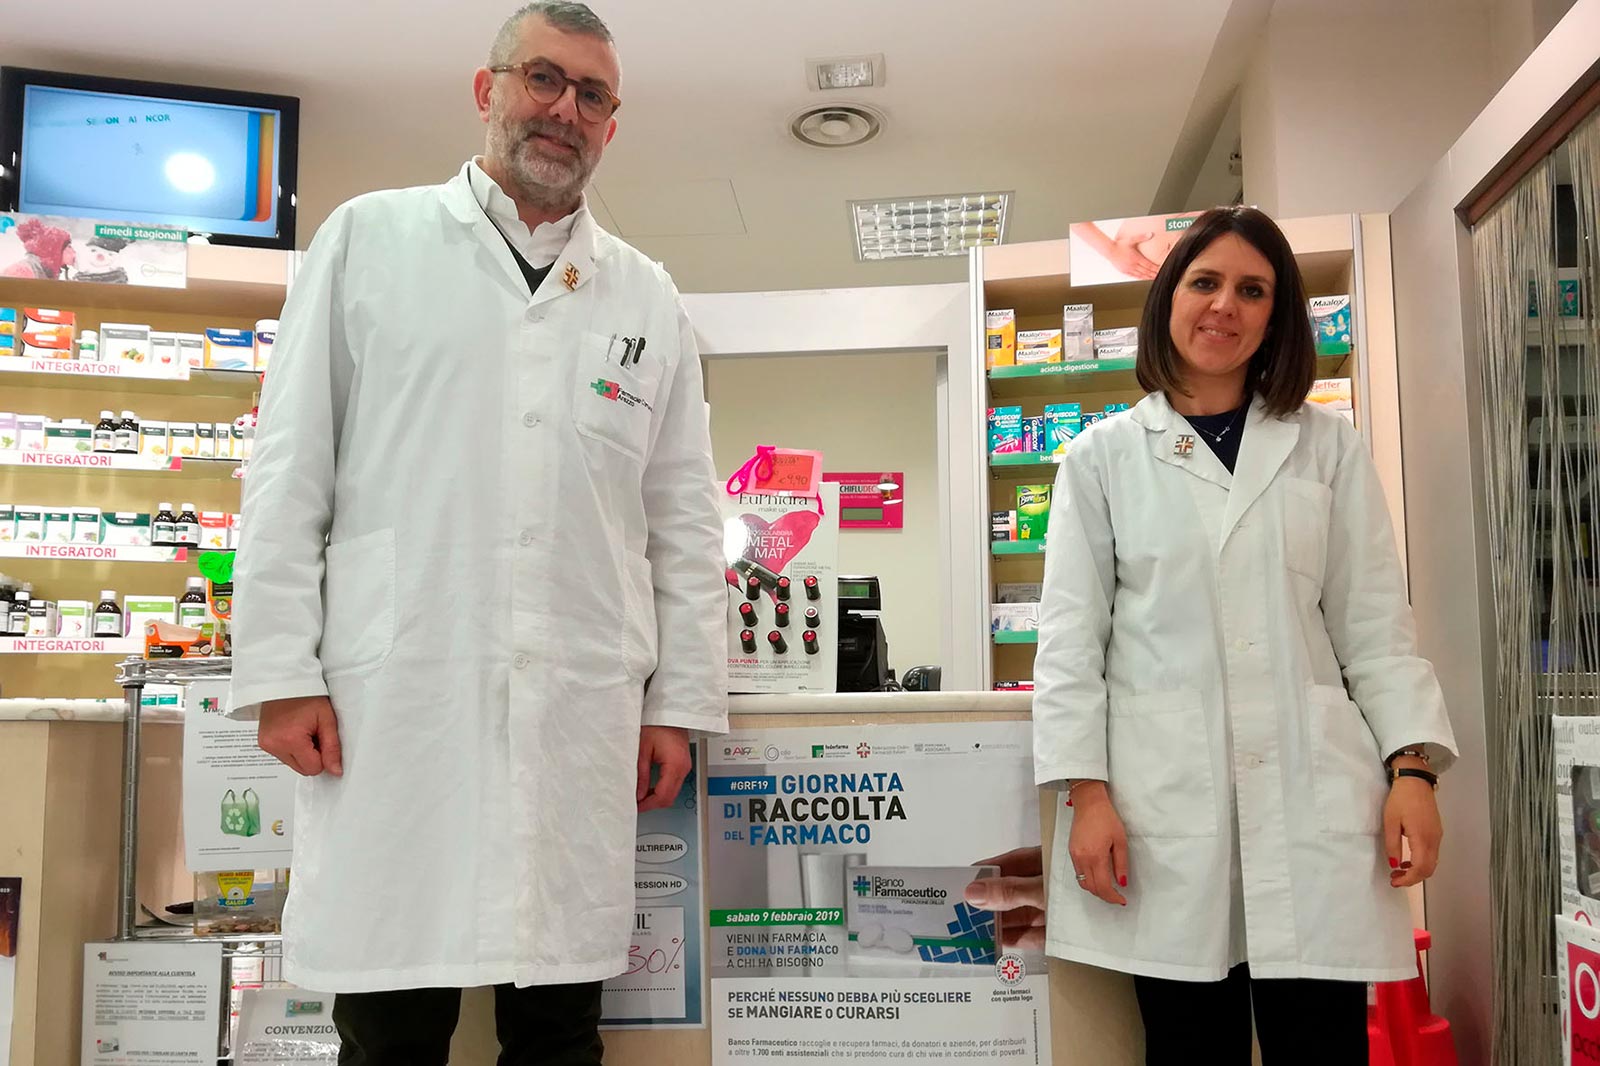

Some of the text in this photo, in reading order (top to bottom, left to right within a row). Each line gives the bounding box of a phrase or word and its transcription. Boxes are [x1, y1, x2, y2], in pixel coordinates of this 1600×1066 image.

[100, 226, 183, 242] rimedi stagionali
[1066, 304, 1090, 312] Maalox
[1313, 298, 1344, 308] Maalox
[988, 310, 1011, 318] Maalox
[31, 360, 120, 375] INTEGRATORI
[1040, 363, 1099, 374] acidità-digestione
[22, 453, 112, 466] INTEGRATORI
[779, 506, 788, 514] up
[746, 536, 794, 548] METAL
[26, 545, 117, 558] INTEGRATORI
[755, 548, 785, 559] MAT
[13, 640, 105, 651] INTEGRATORI
[730, 772, 904, 795] #GRF19 GIORNATA
[724, 795, 907, 823] DI RACCOLTA
[724, 823, 871, 846] DEL FARMACO
[637, 844, 684, 852] ULTIREPAIR
[875, 876, 905, 887] Banco
[875, 886, 947, 898] Farmaceutico
[726, 911, 840, 923] sabato 9 febbraio 2019
[726, 933, 827, 944] VIENI IN FARMACIA
[727, 945, 839, 957] E DONA UN FARMACO
[726, 958, 824, 969] A CHI HA BISOGNO
[728, 988, 972, 1004] PERCHÉ NESSUNO DEBBA PIÙ SCEGLIERE
[728, 1008, 743, 1019] SE
[746, 1005, 822, 1019] MANGIARE
[836, 1006, 900, 1020] CURARSI
[728, 1038, 751, 1047] Banco
[751, 1038, 798, 1047] Farmaceutico
[799, 1040, 831, 1048] raccoglie
[838, 1041, 870, 1049] recupera
[871, 1039, 900, 1048] farmaci,
[901, 1039, 910, 1047] da
[912, 1039, 941, 1047] donatori
[949, 1039, 979, 1048] aziende,
[979, 1040, 991, 1048] per
[734, 1048, 750, 1056] oltre
[752, 1048, 770, 1057] 1.700
[771, 1048, 784, 1057] enti
[786, 1048, 830, 1057] assistenziali
[831, 1049, 844, 1057] che
[845, 1049, 852, 1057] si
[854, 1050, 888, 1059] prendono
[906, 1049, 914, 1058] di
[915, 1049, 927, 1058] chi
[929, 1049, 943, 1058] vive
[945, 1049, 951, 1057] in
[952, 1049, 989, 1057] condizioni
[990, 1049, 997, 1057] di
